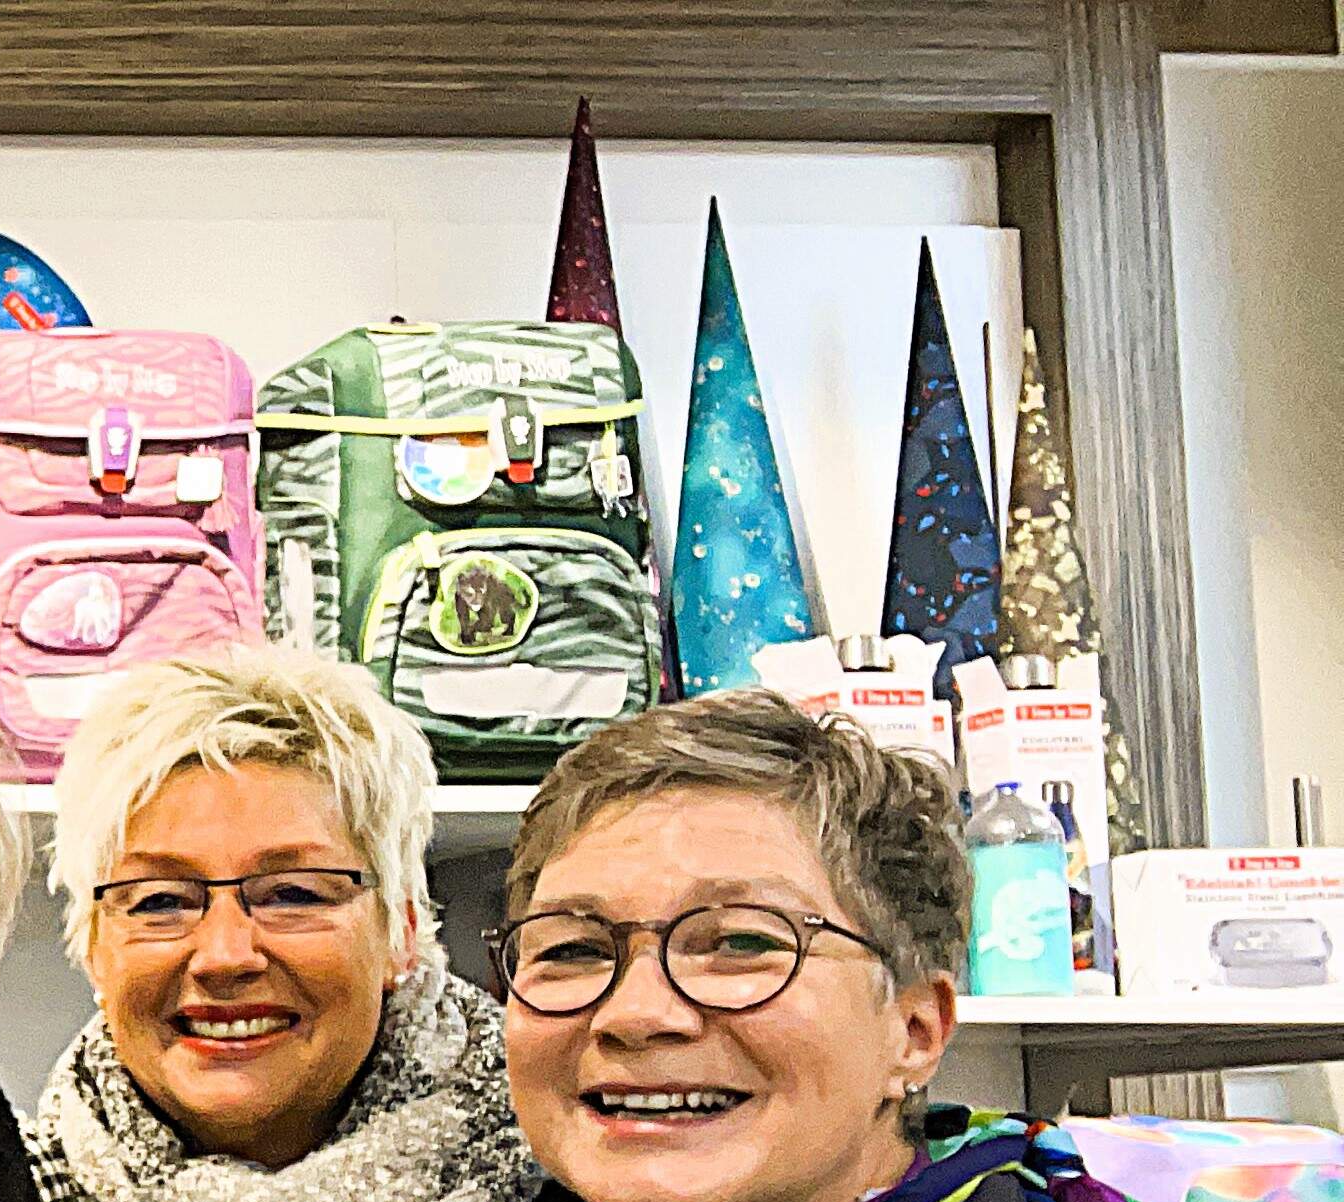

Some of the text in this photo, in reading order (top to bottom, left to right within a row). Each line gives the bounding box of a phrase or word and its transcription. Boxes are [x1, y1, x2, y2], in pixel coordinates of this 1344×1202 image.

[447, 352, 571, 389] Step by Step
